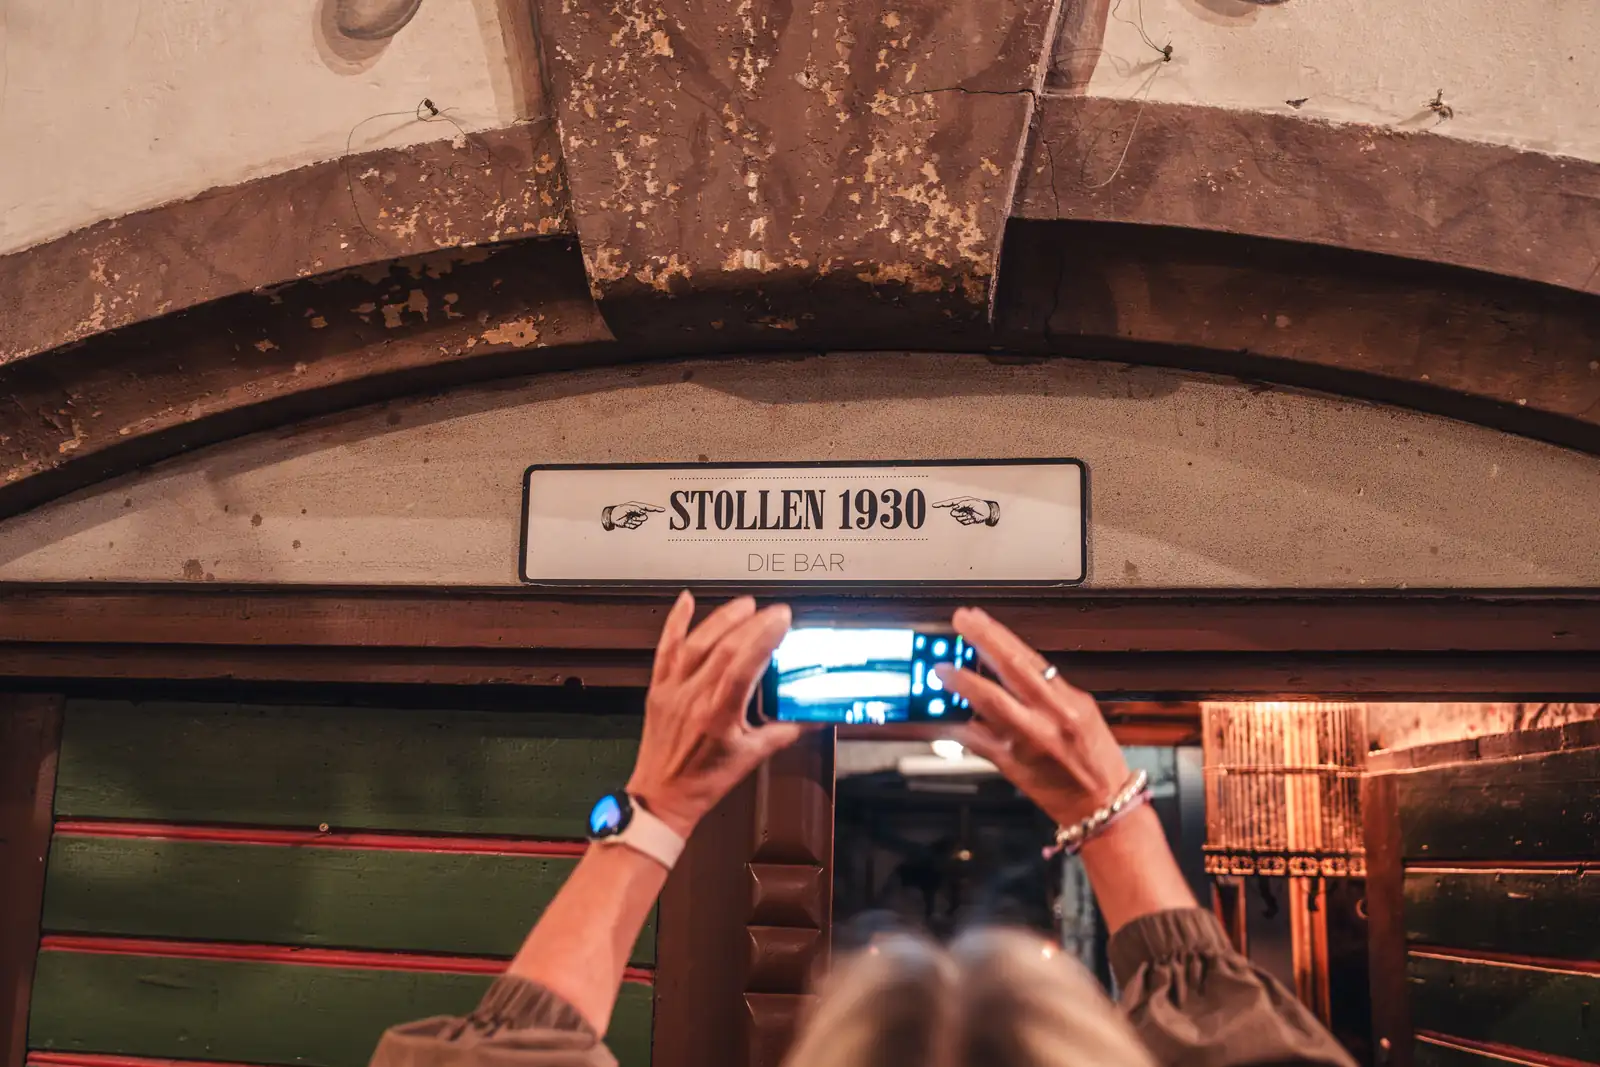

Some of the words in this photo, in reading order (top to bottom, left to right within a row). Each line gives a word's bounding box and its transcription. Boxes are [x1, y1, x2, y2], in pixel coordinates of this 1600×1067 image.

[669, 489, 825, 531] STOLLEN
[838, 488, 926, 530] 1930
[747, 553, 785, 572] DIE
[794, 553, 845, 572] BAR
